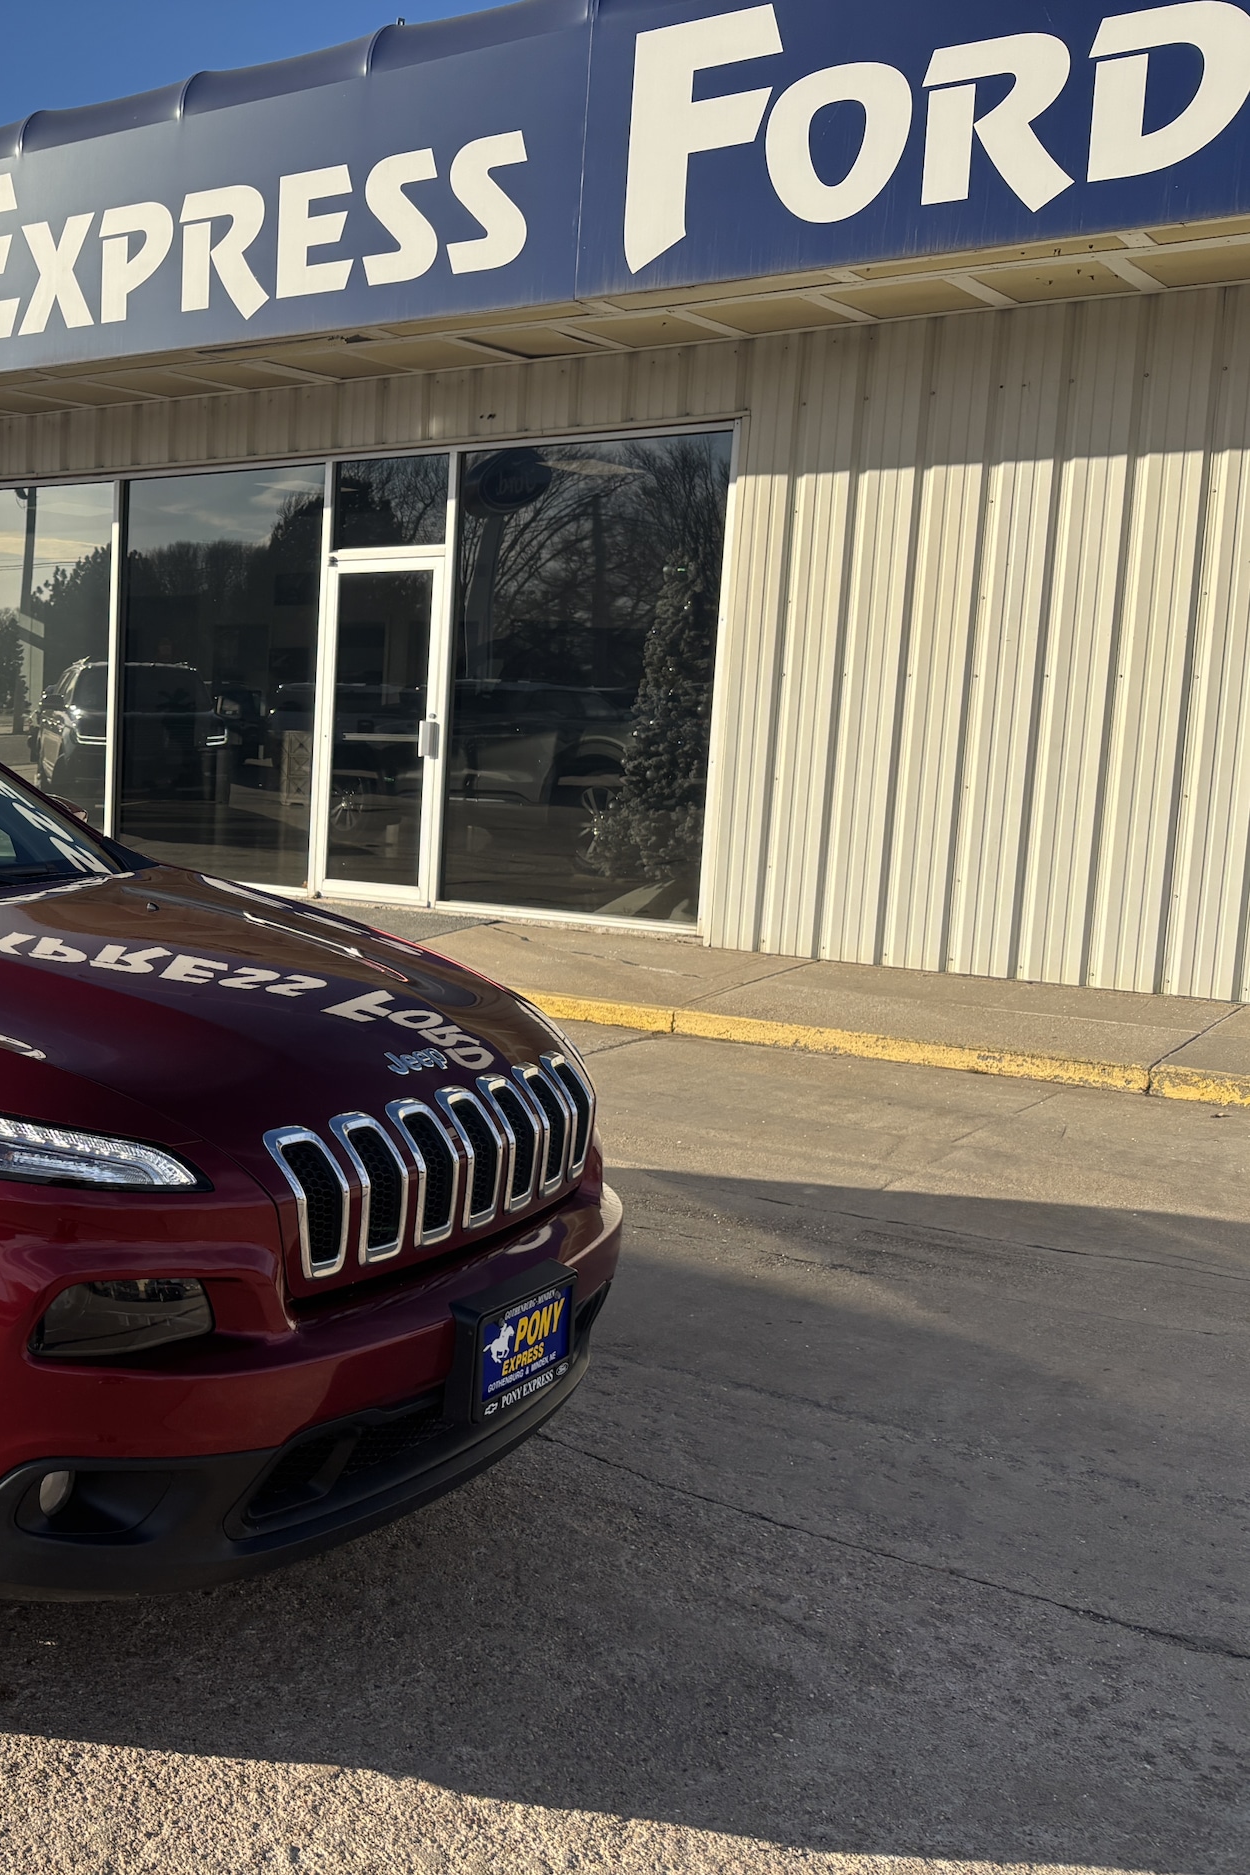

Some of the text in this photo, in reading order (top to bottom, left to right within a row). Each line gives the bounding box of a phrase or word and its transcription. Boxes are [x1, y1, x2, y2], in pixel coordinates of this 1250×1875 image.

[383, 1047, 449, 1076] Jeep
[514, 1297, 565, 1353] PONY
[501, 1342, 545, 1376] EXPRESS
[487, 1368, 524, 1393] GOTHENBURG
[501, 1369, 554, 1409] PONY EXPRESS
